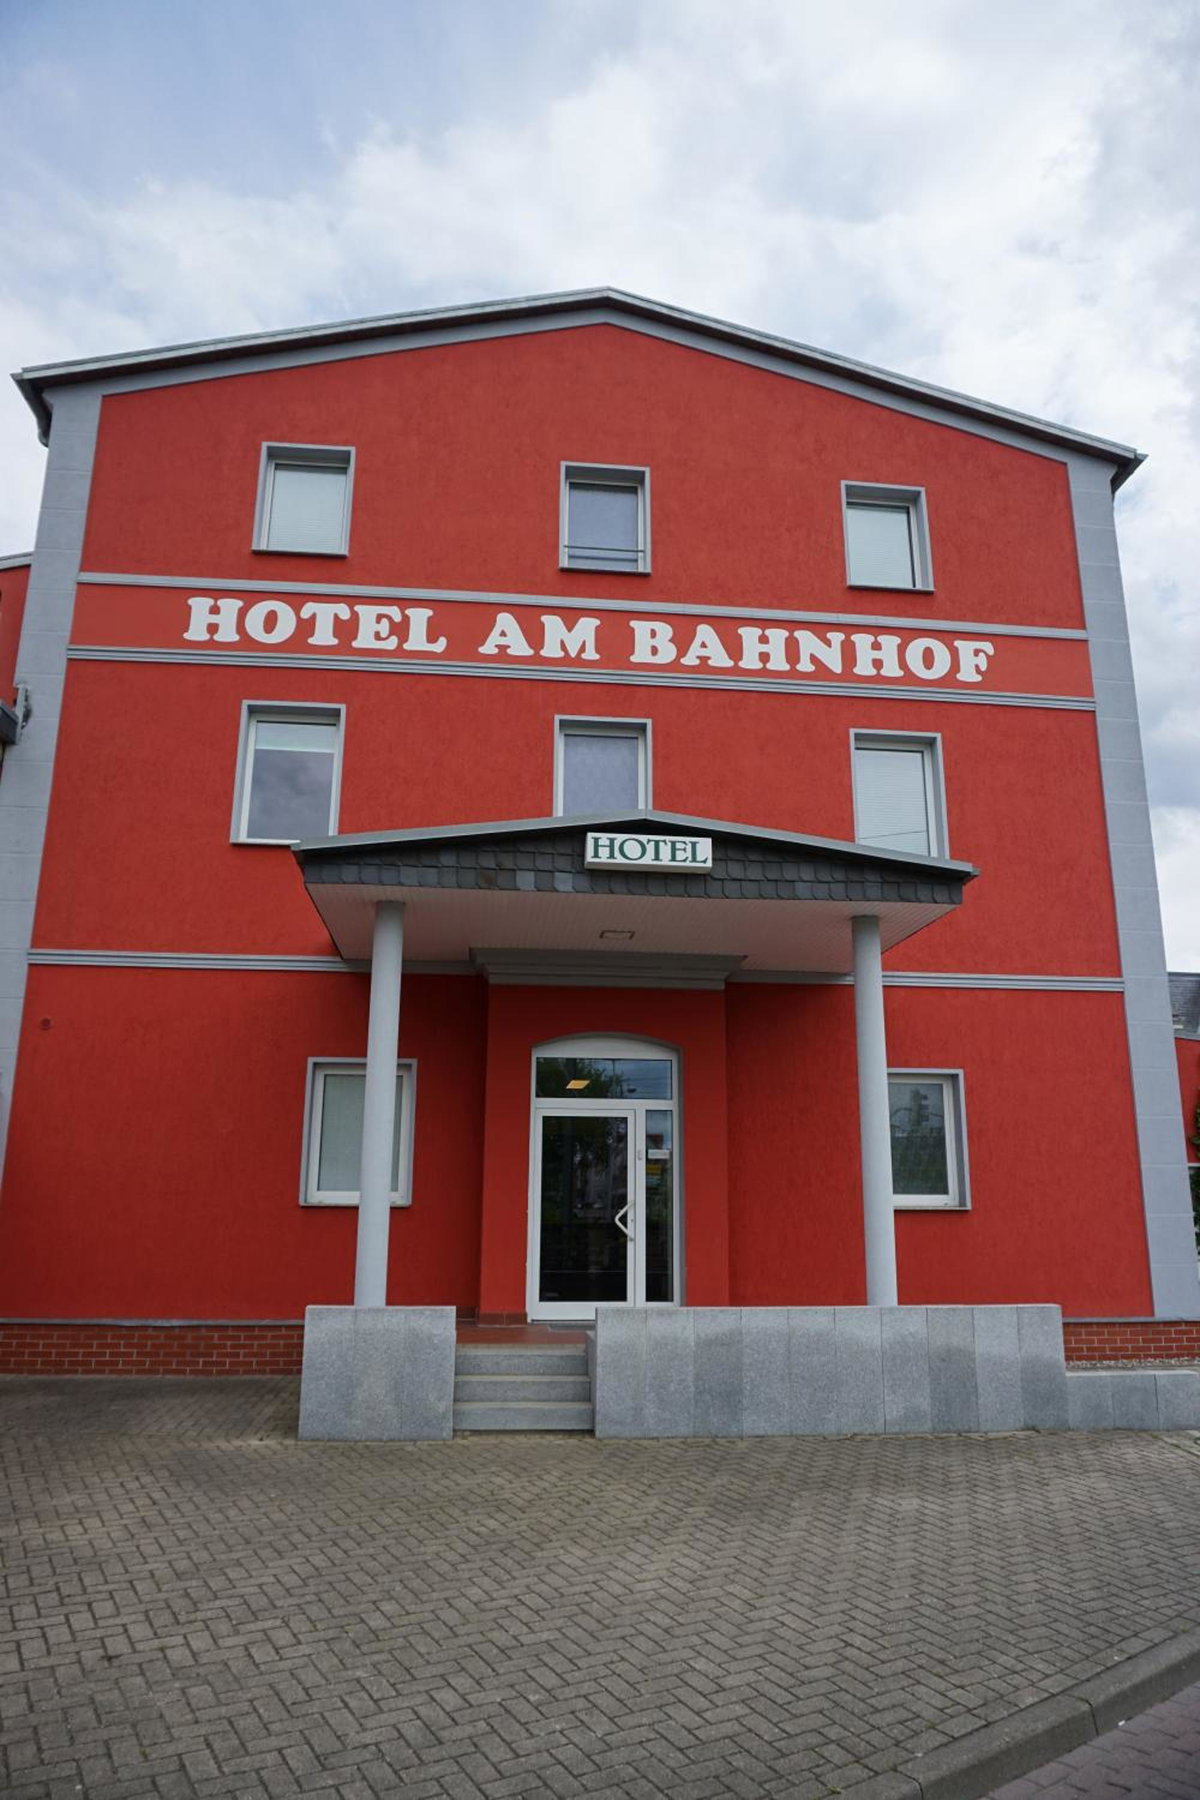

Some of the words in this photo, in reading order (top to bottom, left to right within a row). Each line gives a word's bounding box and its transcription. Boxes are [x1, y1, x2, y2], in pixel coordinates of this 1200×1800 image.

[182, 596, 447, 654] HOTEL
[477, 612, 601, 661] AM
[629, 620, 995, 683] BAHNHOF
[590, 836, 709, 865] HOTEL
